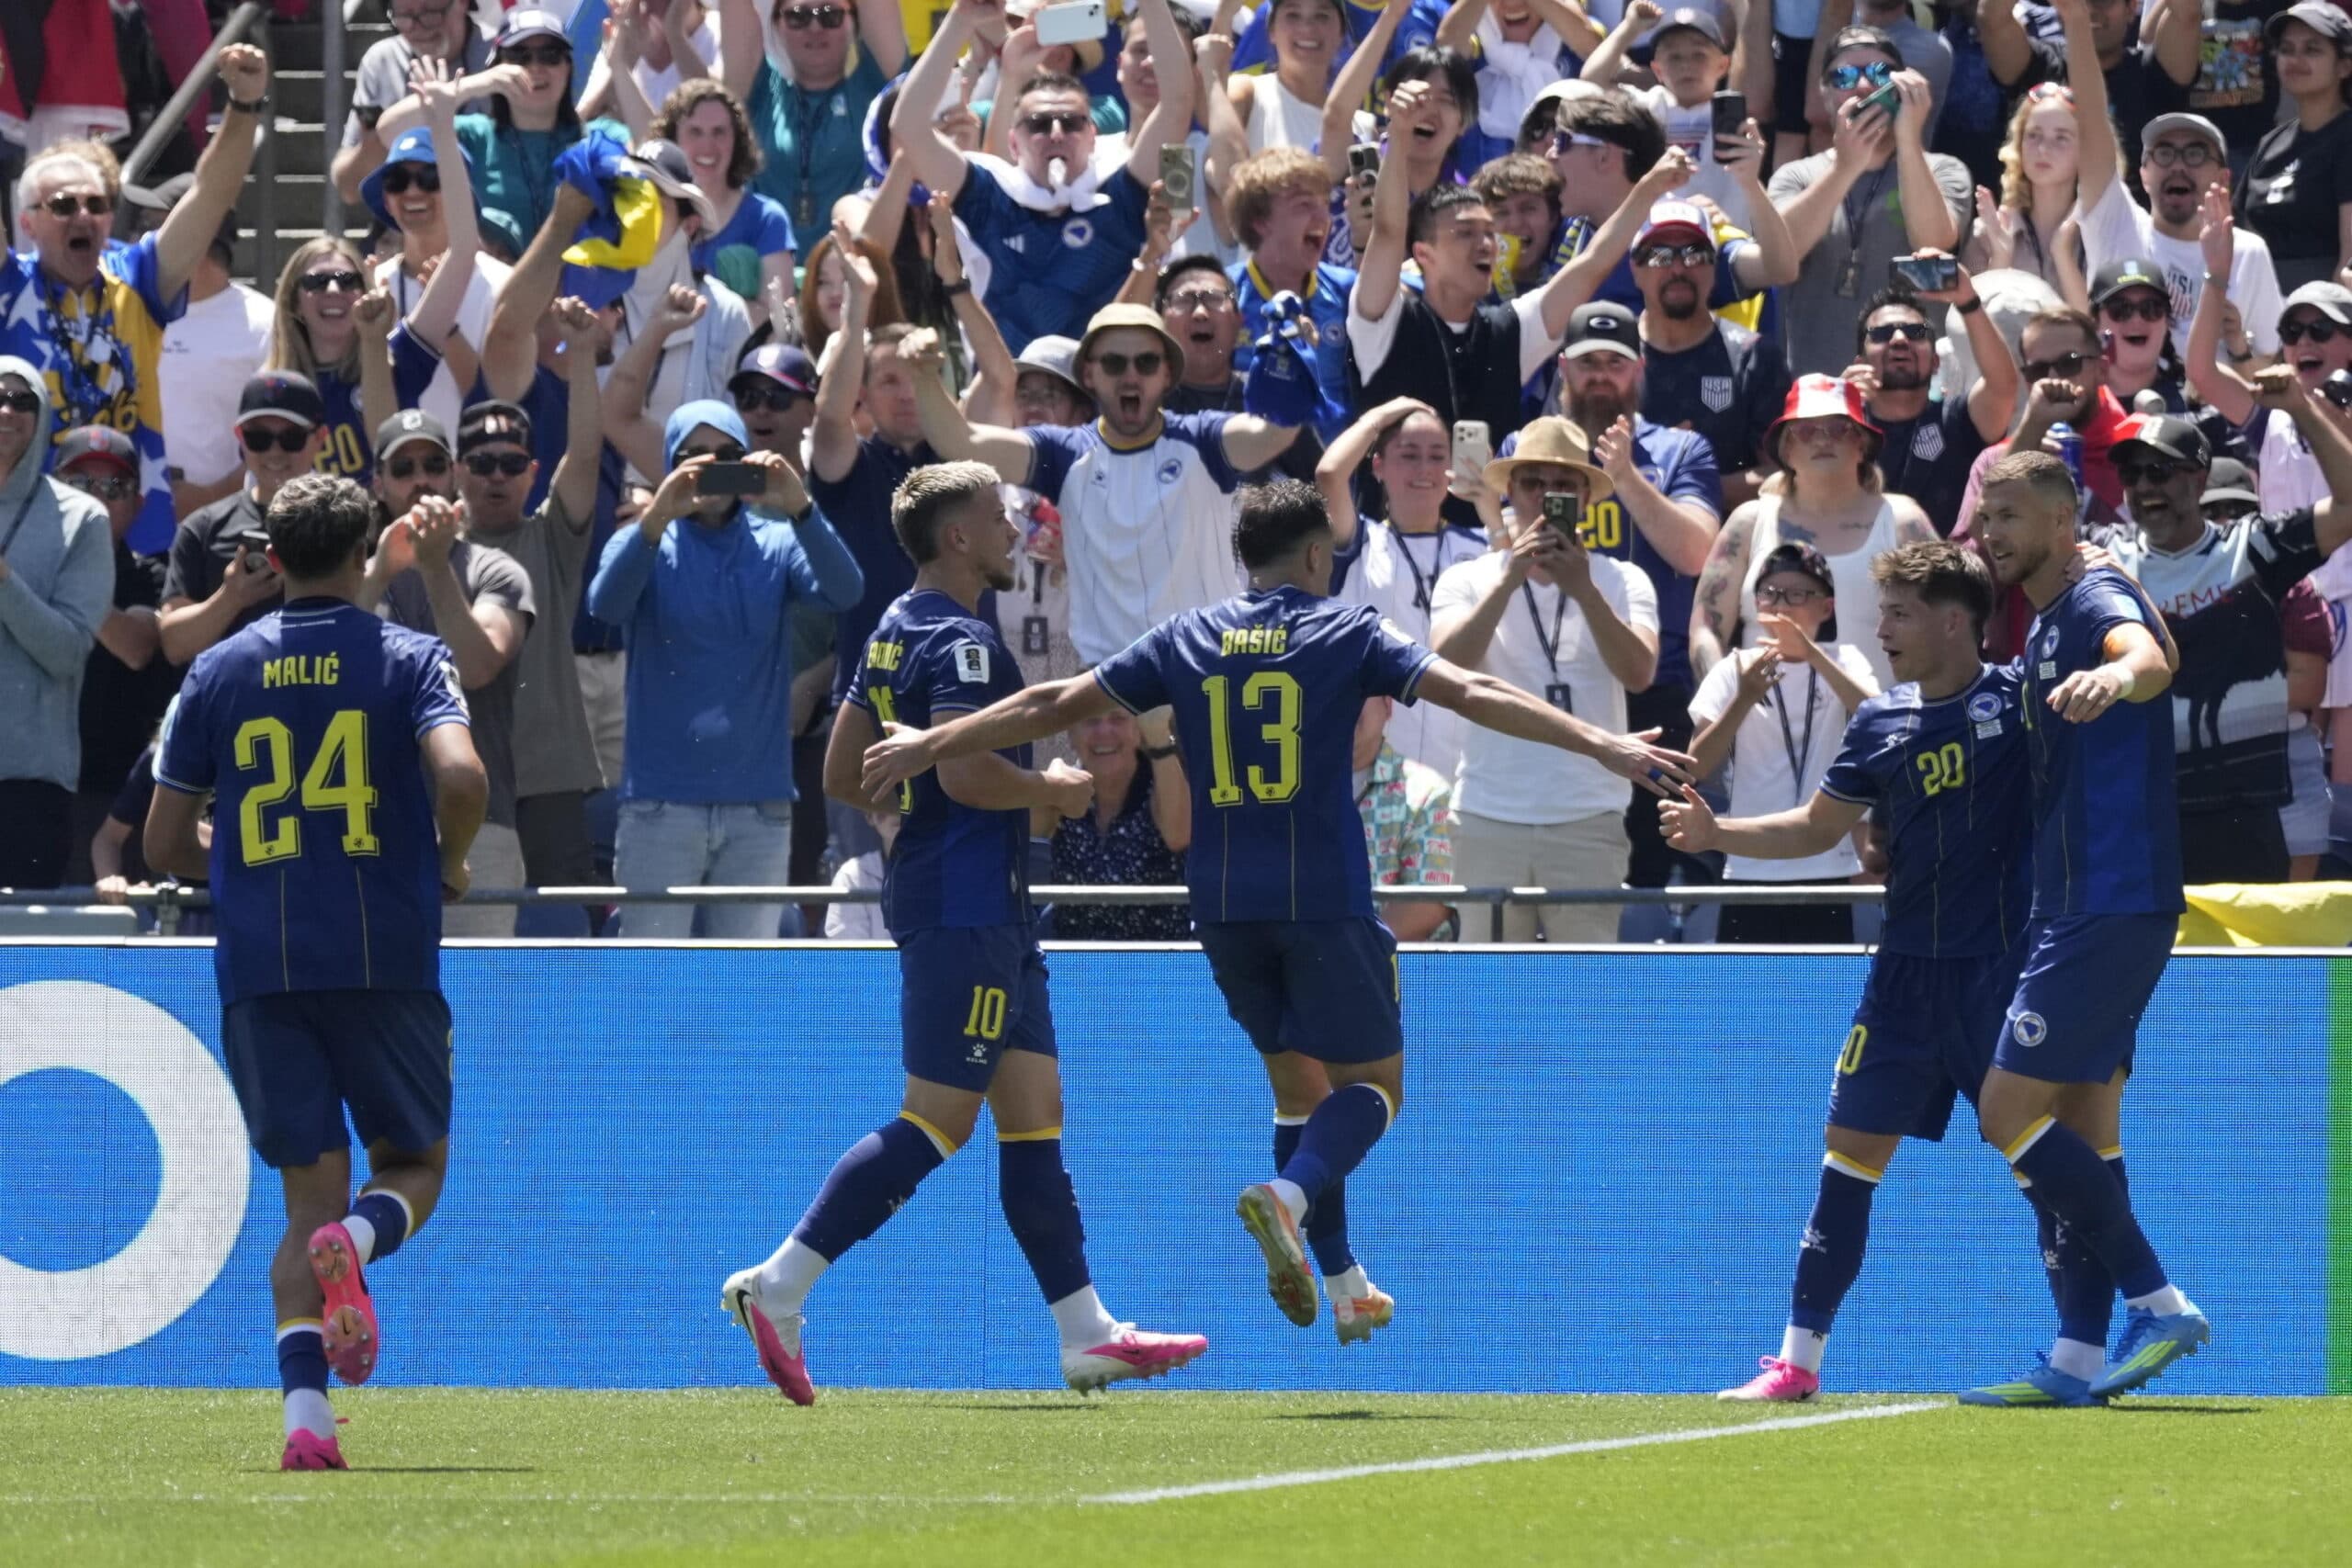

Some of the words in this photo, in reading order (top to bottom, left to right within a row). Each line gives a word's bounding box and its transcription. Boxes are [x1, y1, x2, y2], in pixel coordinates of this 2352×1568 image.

[1220, 624, 1287, 657] BAŠIĆ
[263, 651, 339, 689] MALIĆ
[1202, 671, 1303, 807] 13
[234, 710, 380, 867] 24
[1917, 742, 1965, 796] 20
[964, 986, 1007, 1040] 10
[1838, 1024, 1868, 1075] 0
